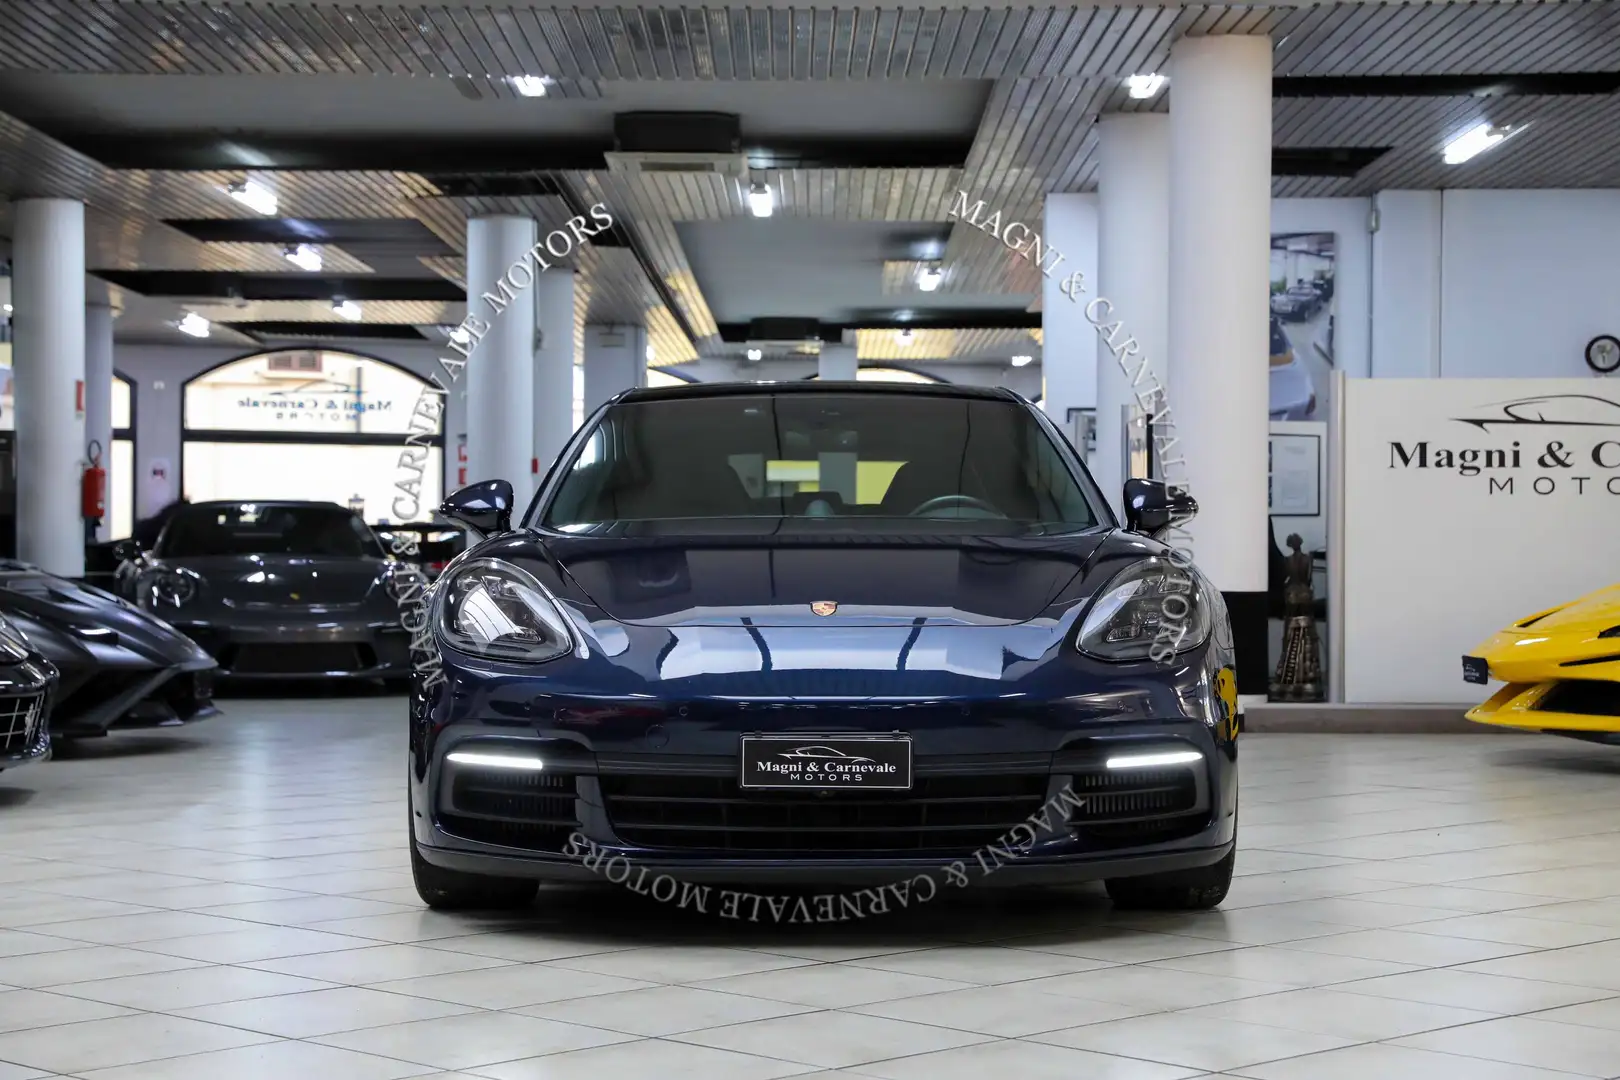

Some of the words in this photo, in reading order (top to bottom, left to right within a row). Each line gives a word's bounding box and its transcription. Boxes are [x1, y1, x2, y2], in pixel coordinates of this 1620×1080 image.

[1388, 440, 1522, 477] Magni
[1537, 441, 1575, 469] &
[756, 761, 802, 774] Magni
[806, 761, 820, 772] &
[824, 762, 897, 773] Carnevale
[790, 773, 863, 781] MOTORS
